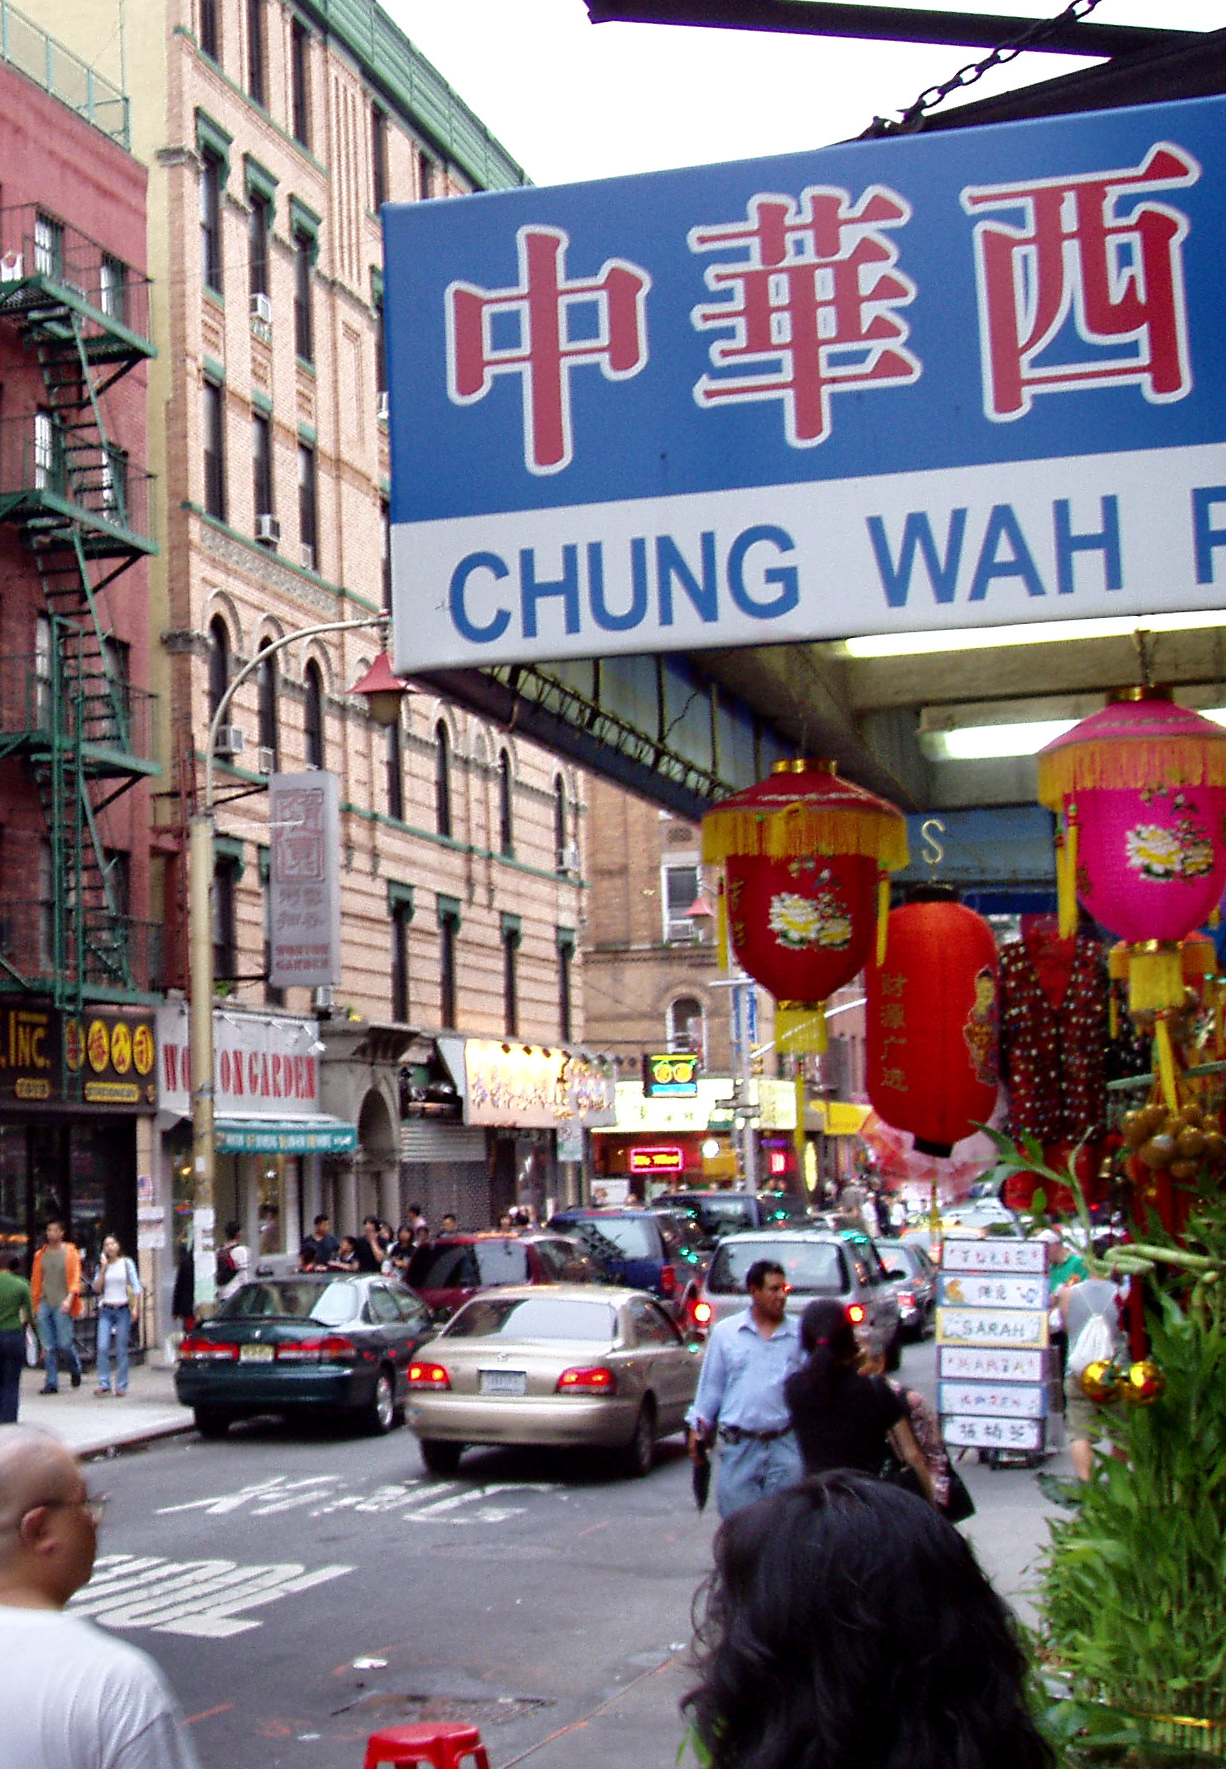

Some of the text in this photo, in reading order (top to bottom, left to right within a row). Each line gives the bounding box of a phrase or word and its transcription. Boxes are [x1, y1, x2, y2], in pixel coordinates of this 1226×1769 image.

[448, 523, 800, 643] CHUNG
[866, 494, 1123, 608] WAH
[248, 1051, 316, 1100] GARDEN
[963, 1319, 1025, 1337] SARAH
